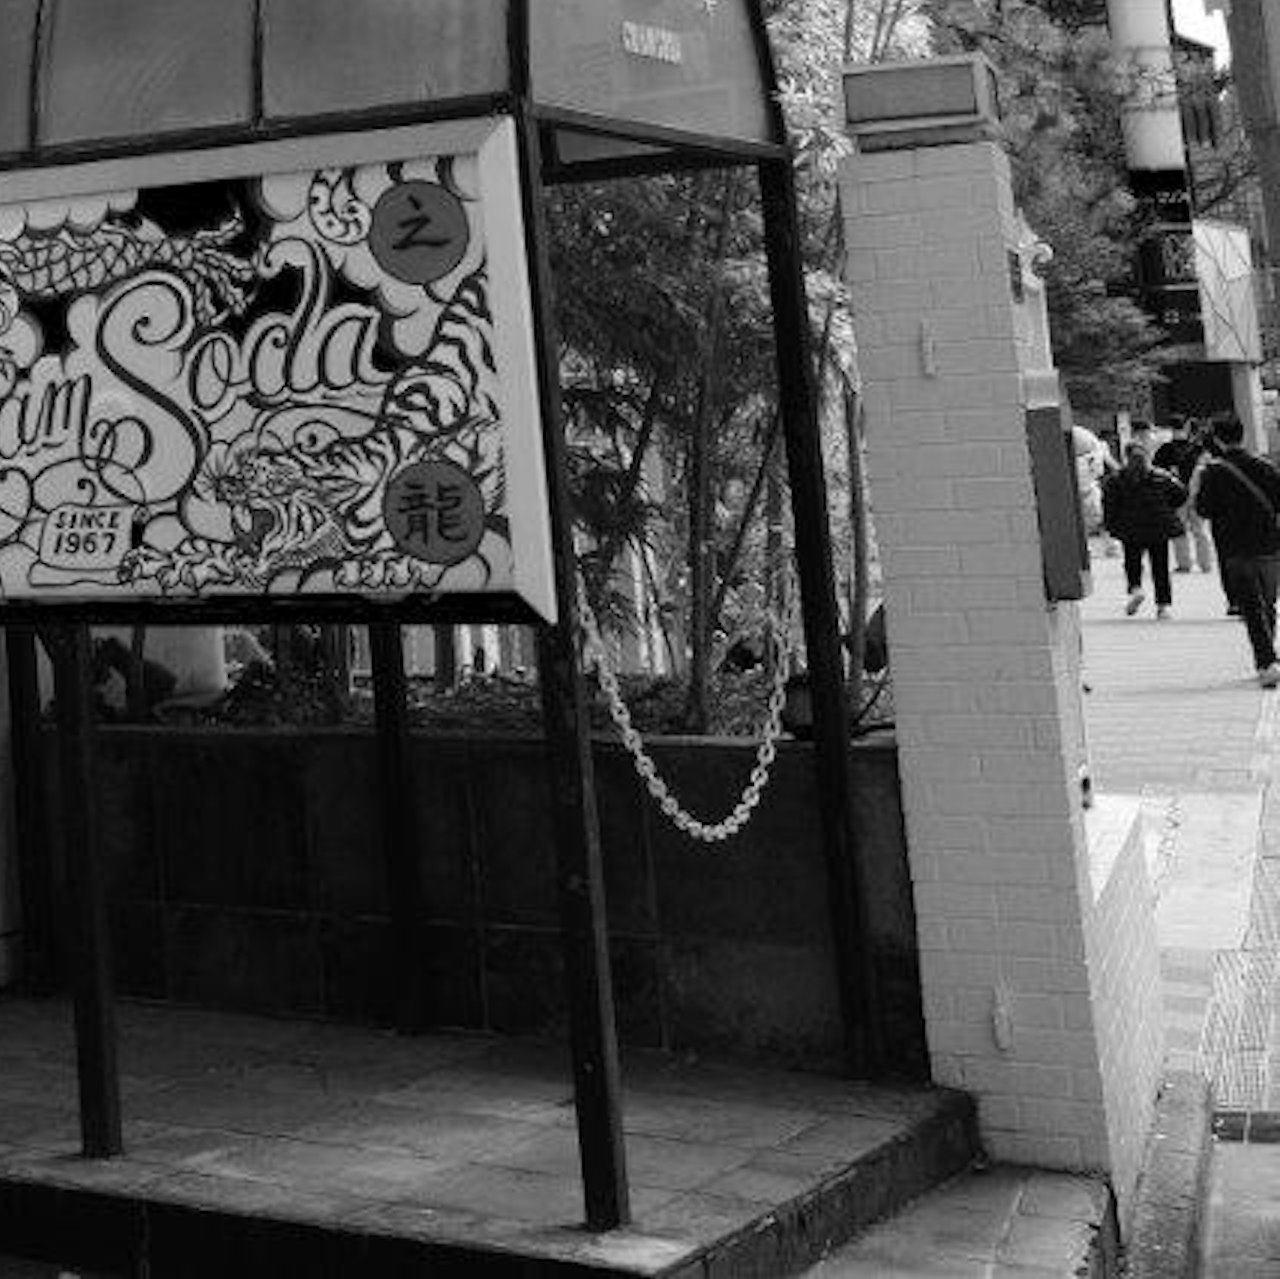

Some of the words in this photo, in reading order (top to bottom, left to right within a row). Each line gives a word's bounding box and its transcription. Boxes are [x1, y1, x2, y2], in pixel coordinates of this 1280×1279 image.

[392, 198, 450, 252] 之
[80, 237, 392, 504] Soda
[55, 511, 120, 529] SINCE
[398, 482, 468, 546] 龍
[54, 532, 116, 555] 1967
